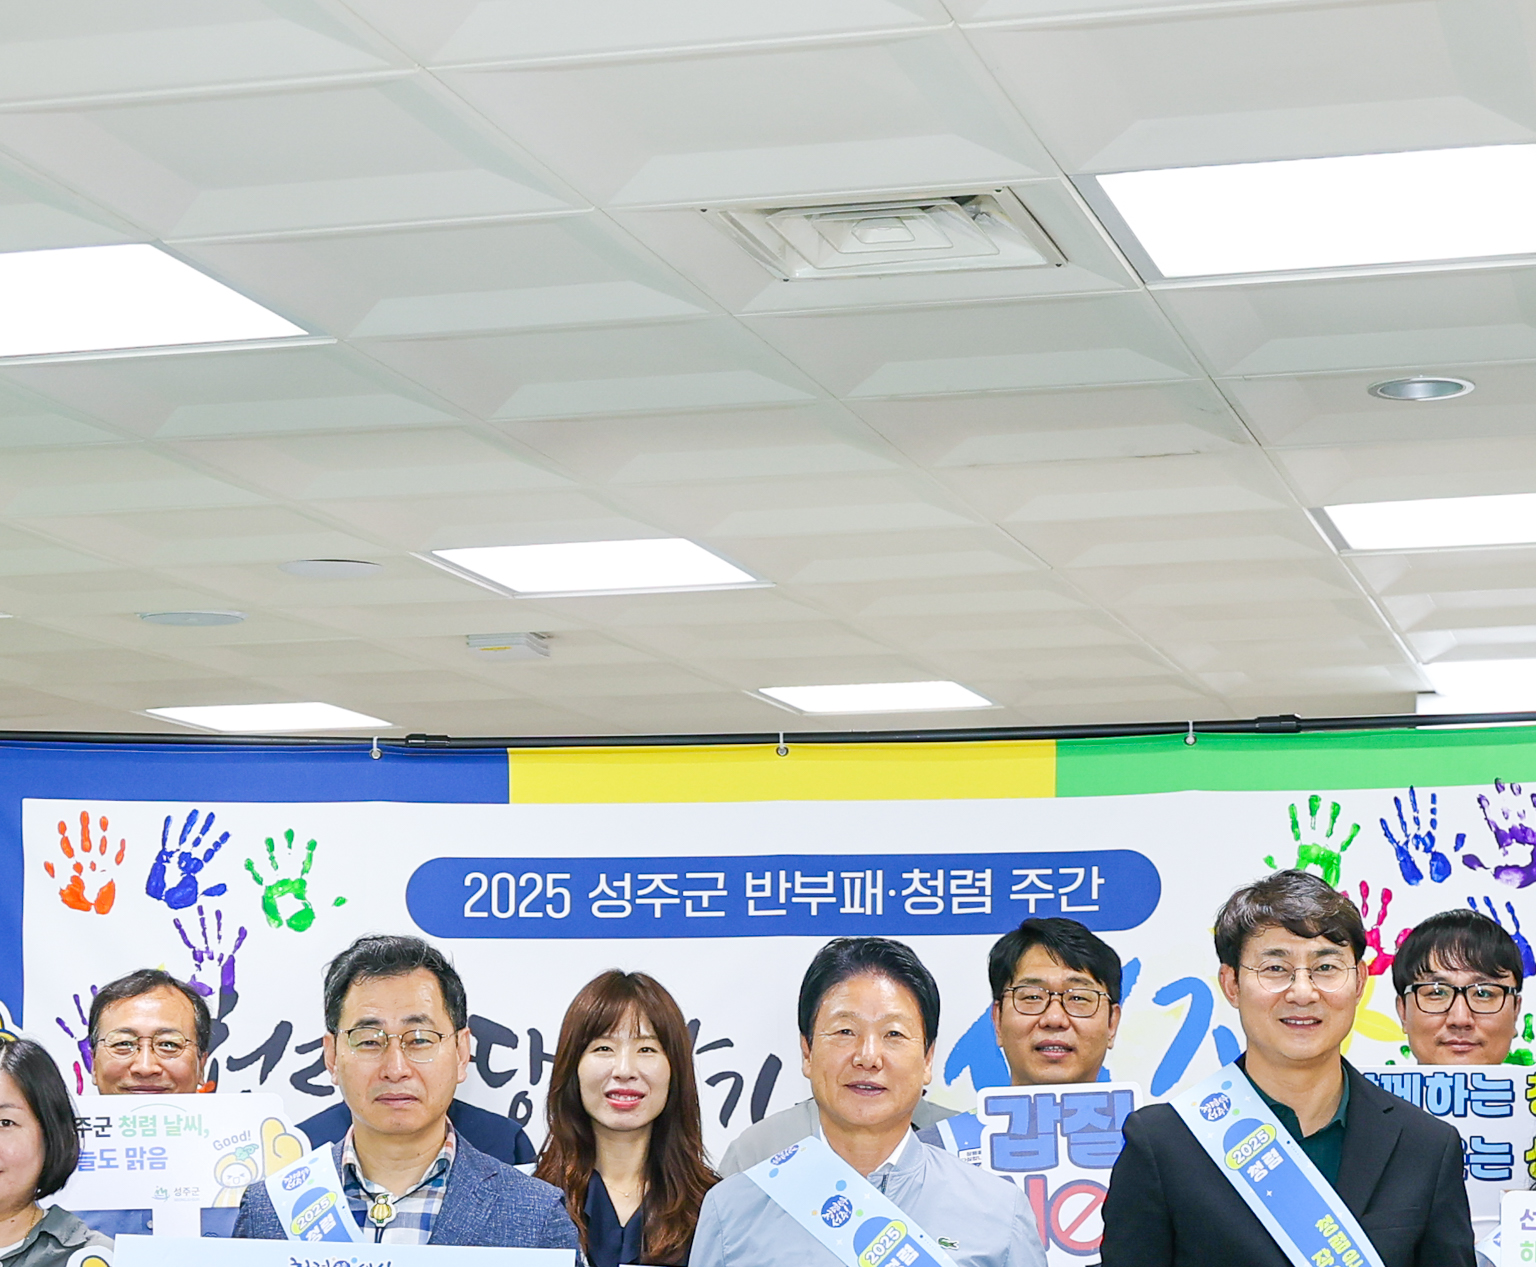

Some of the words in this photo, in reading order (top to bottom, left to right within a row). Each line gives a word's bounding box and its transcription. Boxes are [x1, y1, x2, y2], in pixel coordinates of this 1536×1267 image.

[463, 871, 571, 919] 2025
[587, 869, 729, 920] 성주군
[744, 866, 994, 917] 반부패·청렴
[1008, 864, 1106, 915] 주간
[1364, 1071, 1515, 1118] 께하는
[73, 1116, 113, 1139] 주군
[117, 1114, 158, 1138] 청렴
[163, 1113, 210, 1140] 날씨,
[212, 1130, 253, 1152] Good!
[984, 1089, 1135, 1172] 갑질
[77, 1148, 120, 1173] 늘도
[124, 1146, 169, 1171] 맑음
[1231, 1129, 1271, 1165] 2025
[1246, 1146, 1285, 1184] 청렴
[172, 1185, 201, 1198] 성주군
[296, 1196, 331, 1231] 2025
[305, 1212, 337, 1241] 청렴
[864, 1227, 902, 1265] 2025
